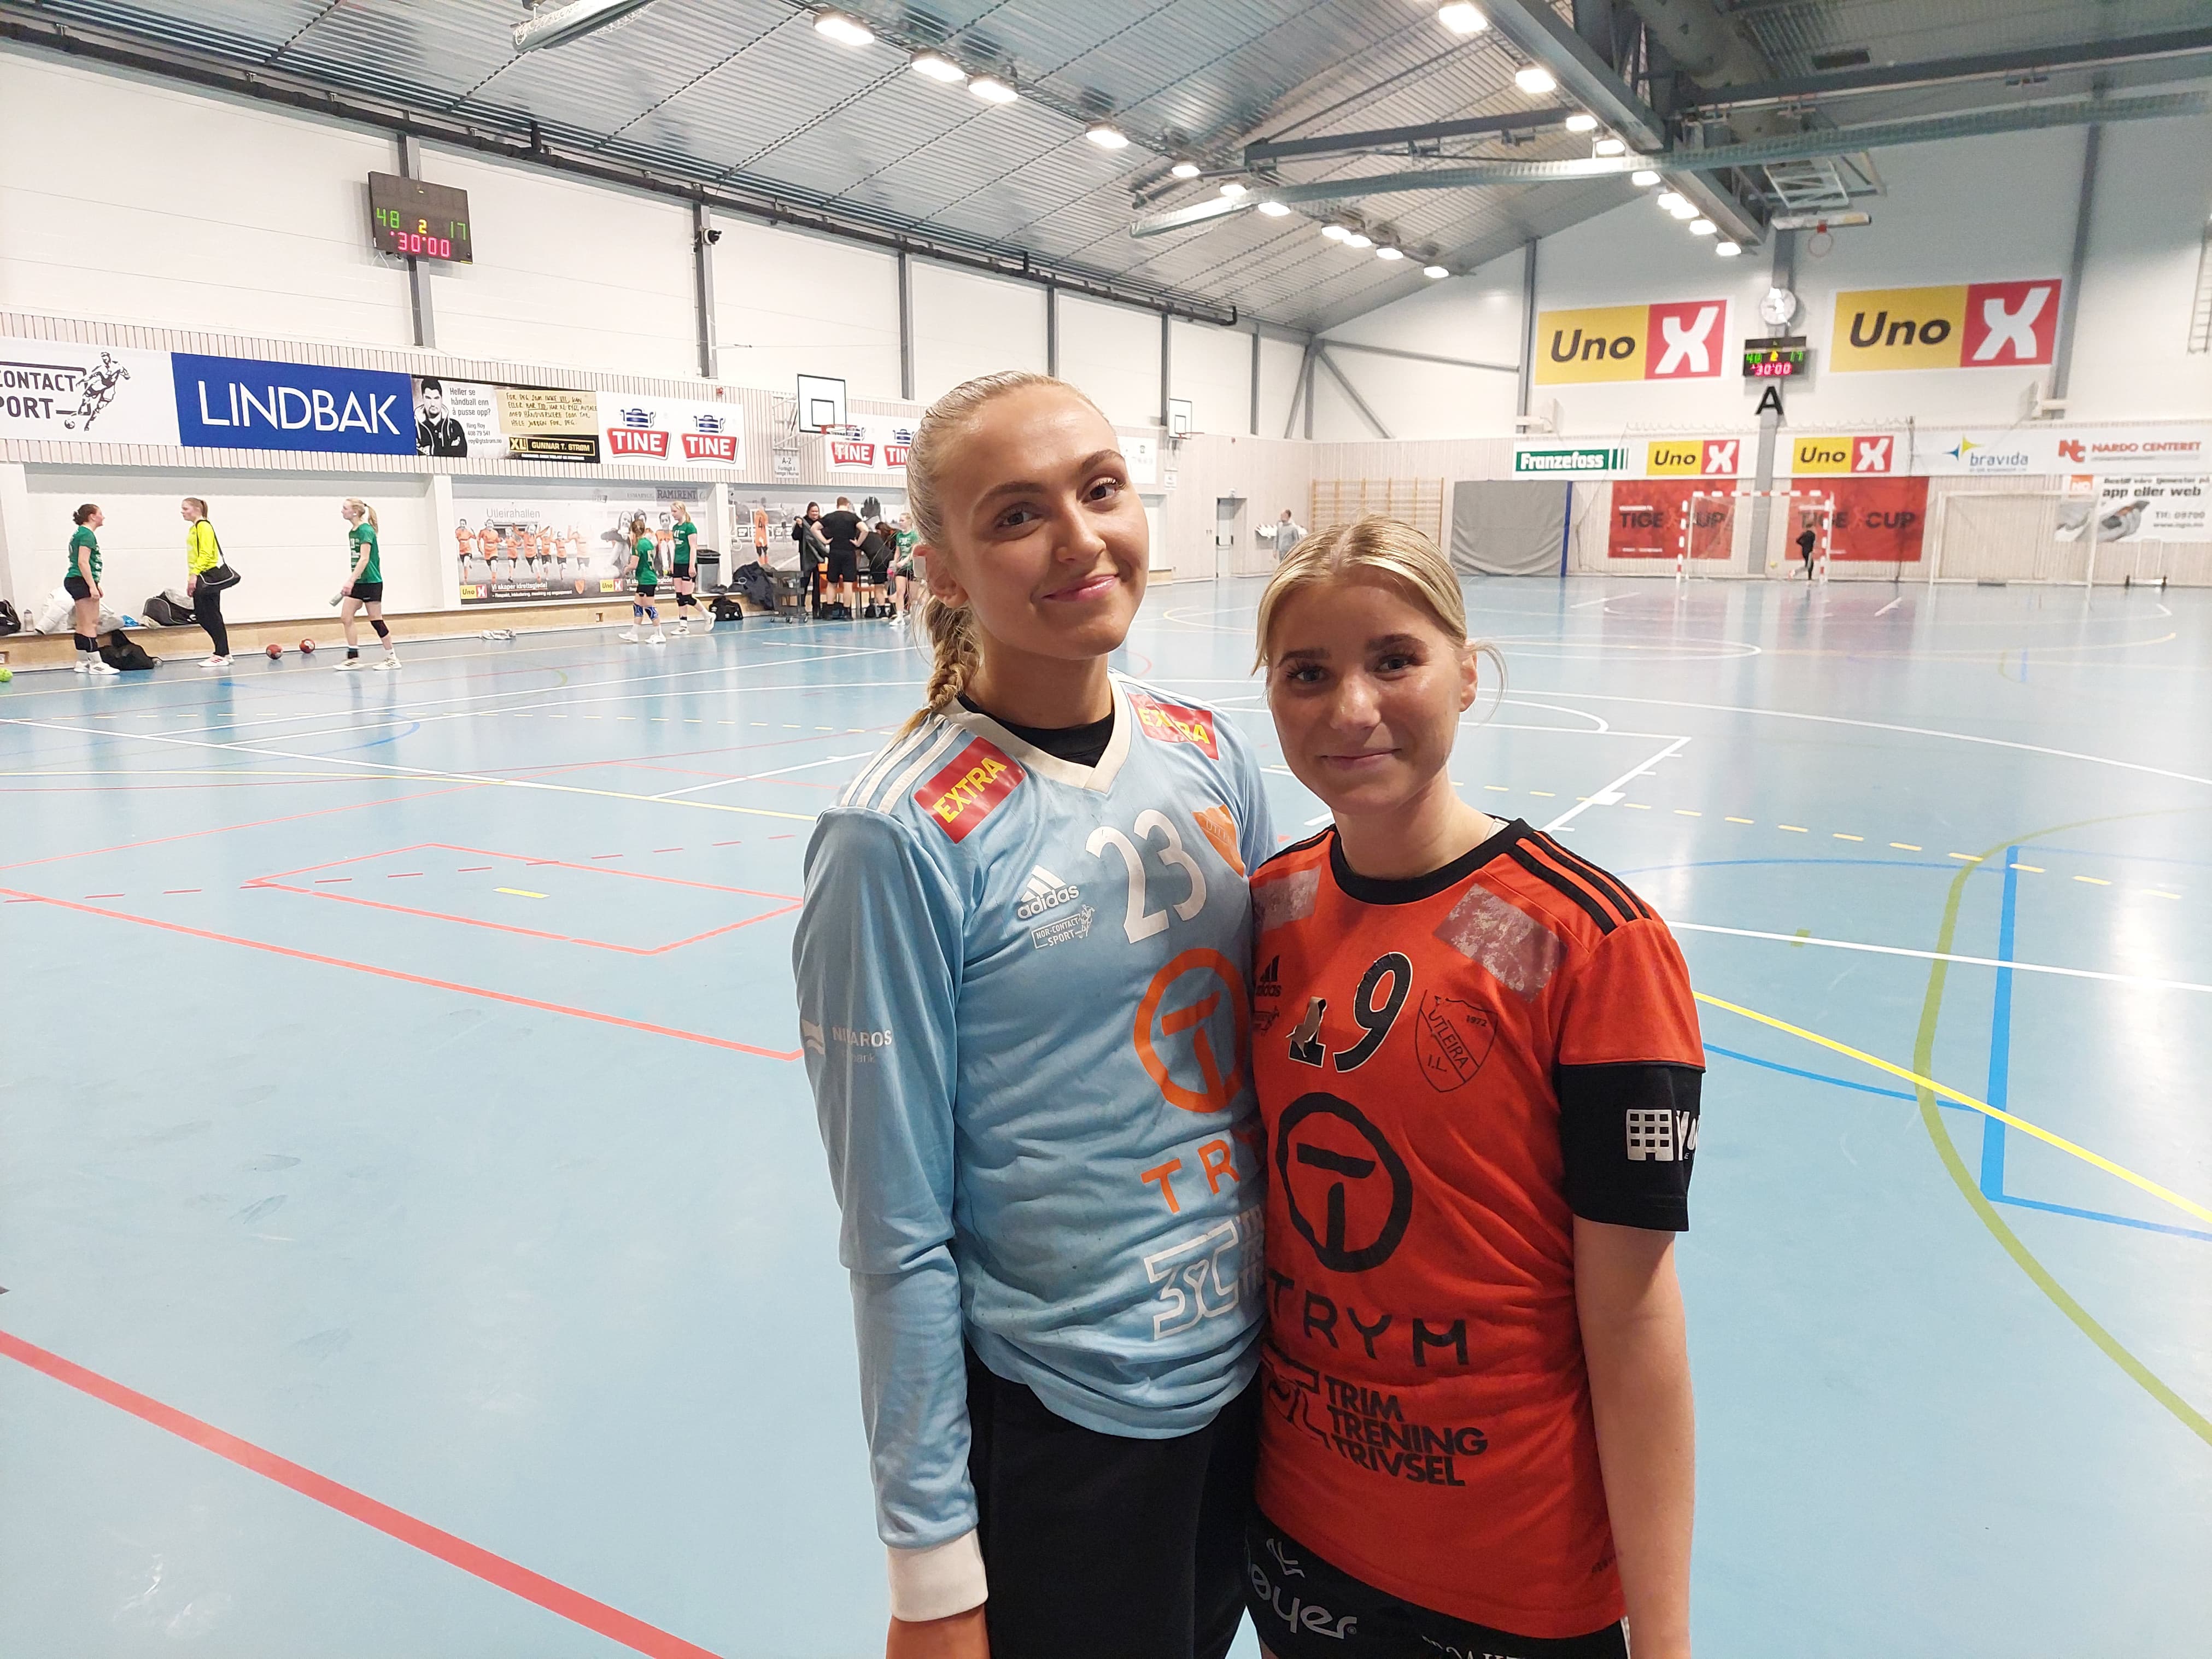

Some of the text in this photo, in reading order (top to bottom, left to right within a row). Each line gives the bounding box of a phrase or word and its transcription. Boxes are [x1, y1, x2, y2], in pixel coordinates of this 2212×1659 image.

[377, 208, 466, 240] 48 2 17
[1850, 287, 2051, 361] Uno X
[1551, 306, 1719, 374] Uno X
[0, 370, 76, 392] ONTACT
[0, 396, 54, 419] ORT
[198, 380, 401, 435] LINDBAK
[451, 397, 476, 406] håndball
[1755, 386, 1784, 415] A
[477, 408, 490, 417] opp?
[510, 438, 526, 450] XL
[531, 442, 560, 450] GUNNAR
[612, 431, 662, 452] TINE
[686, 437, 731, 455] TINE
[835, 444, 870, 461] TINE
[2092, 442, 2201, 453] NARDO CENTERET
[887, 447, 910, 463] TIN
[1520, 452, 1605, 470] Franzefoss
[1655, 441, 1736, 473] Uno X
[1800, 439, 1889, 471] Uno X
[1970, 452, 2029, 466] bravida
[657, 489, 696, 500] RAMIRENT
[2103, 486, 2202, 499] app eller web
[1866, 512, 1916, 529] CUP
[477, 585, 486, 597] X
[614, 581, 621, 591] X
[1137, 707, 1210, 744] EXRA
[932, 758, 1007, 823] EXTRA
[1085, 808, 1207, 944] 23
[1017, 886, 1079, 919] adidas
[1035, 917, 1079, 939] NOR-CONTACT
[1048, 929, 1074, 946] SPORT
[1467, 1015, 1487, 1027] 1972
[1429, 1010, 1468, 1069] UTLEIRA
[1267, 1268, 1470, 1367] TRYM
[1325, 1376, 1405, 1422] TRIM
[1327, 1405, 1488, 1456] TRENING
[1331, 1433, 1466, 1487] TRIVSEL
